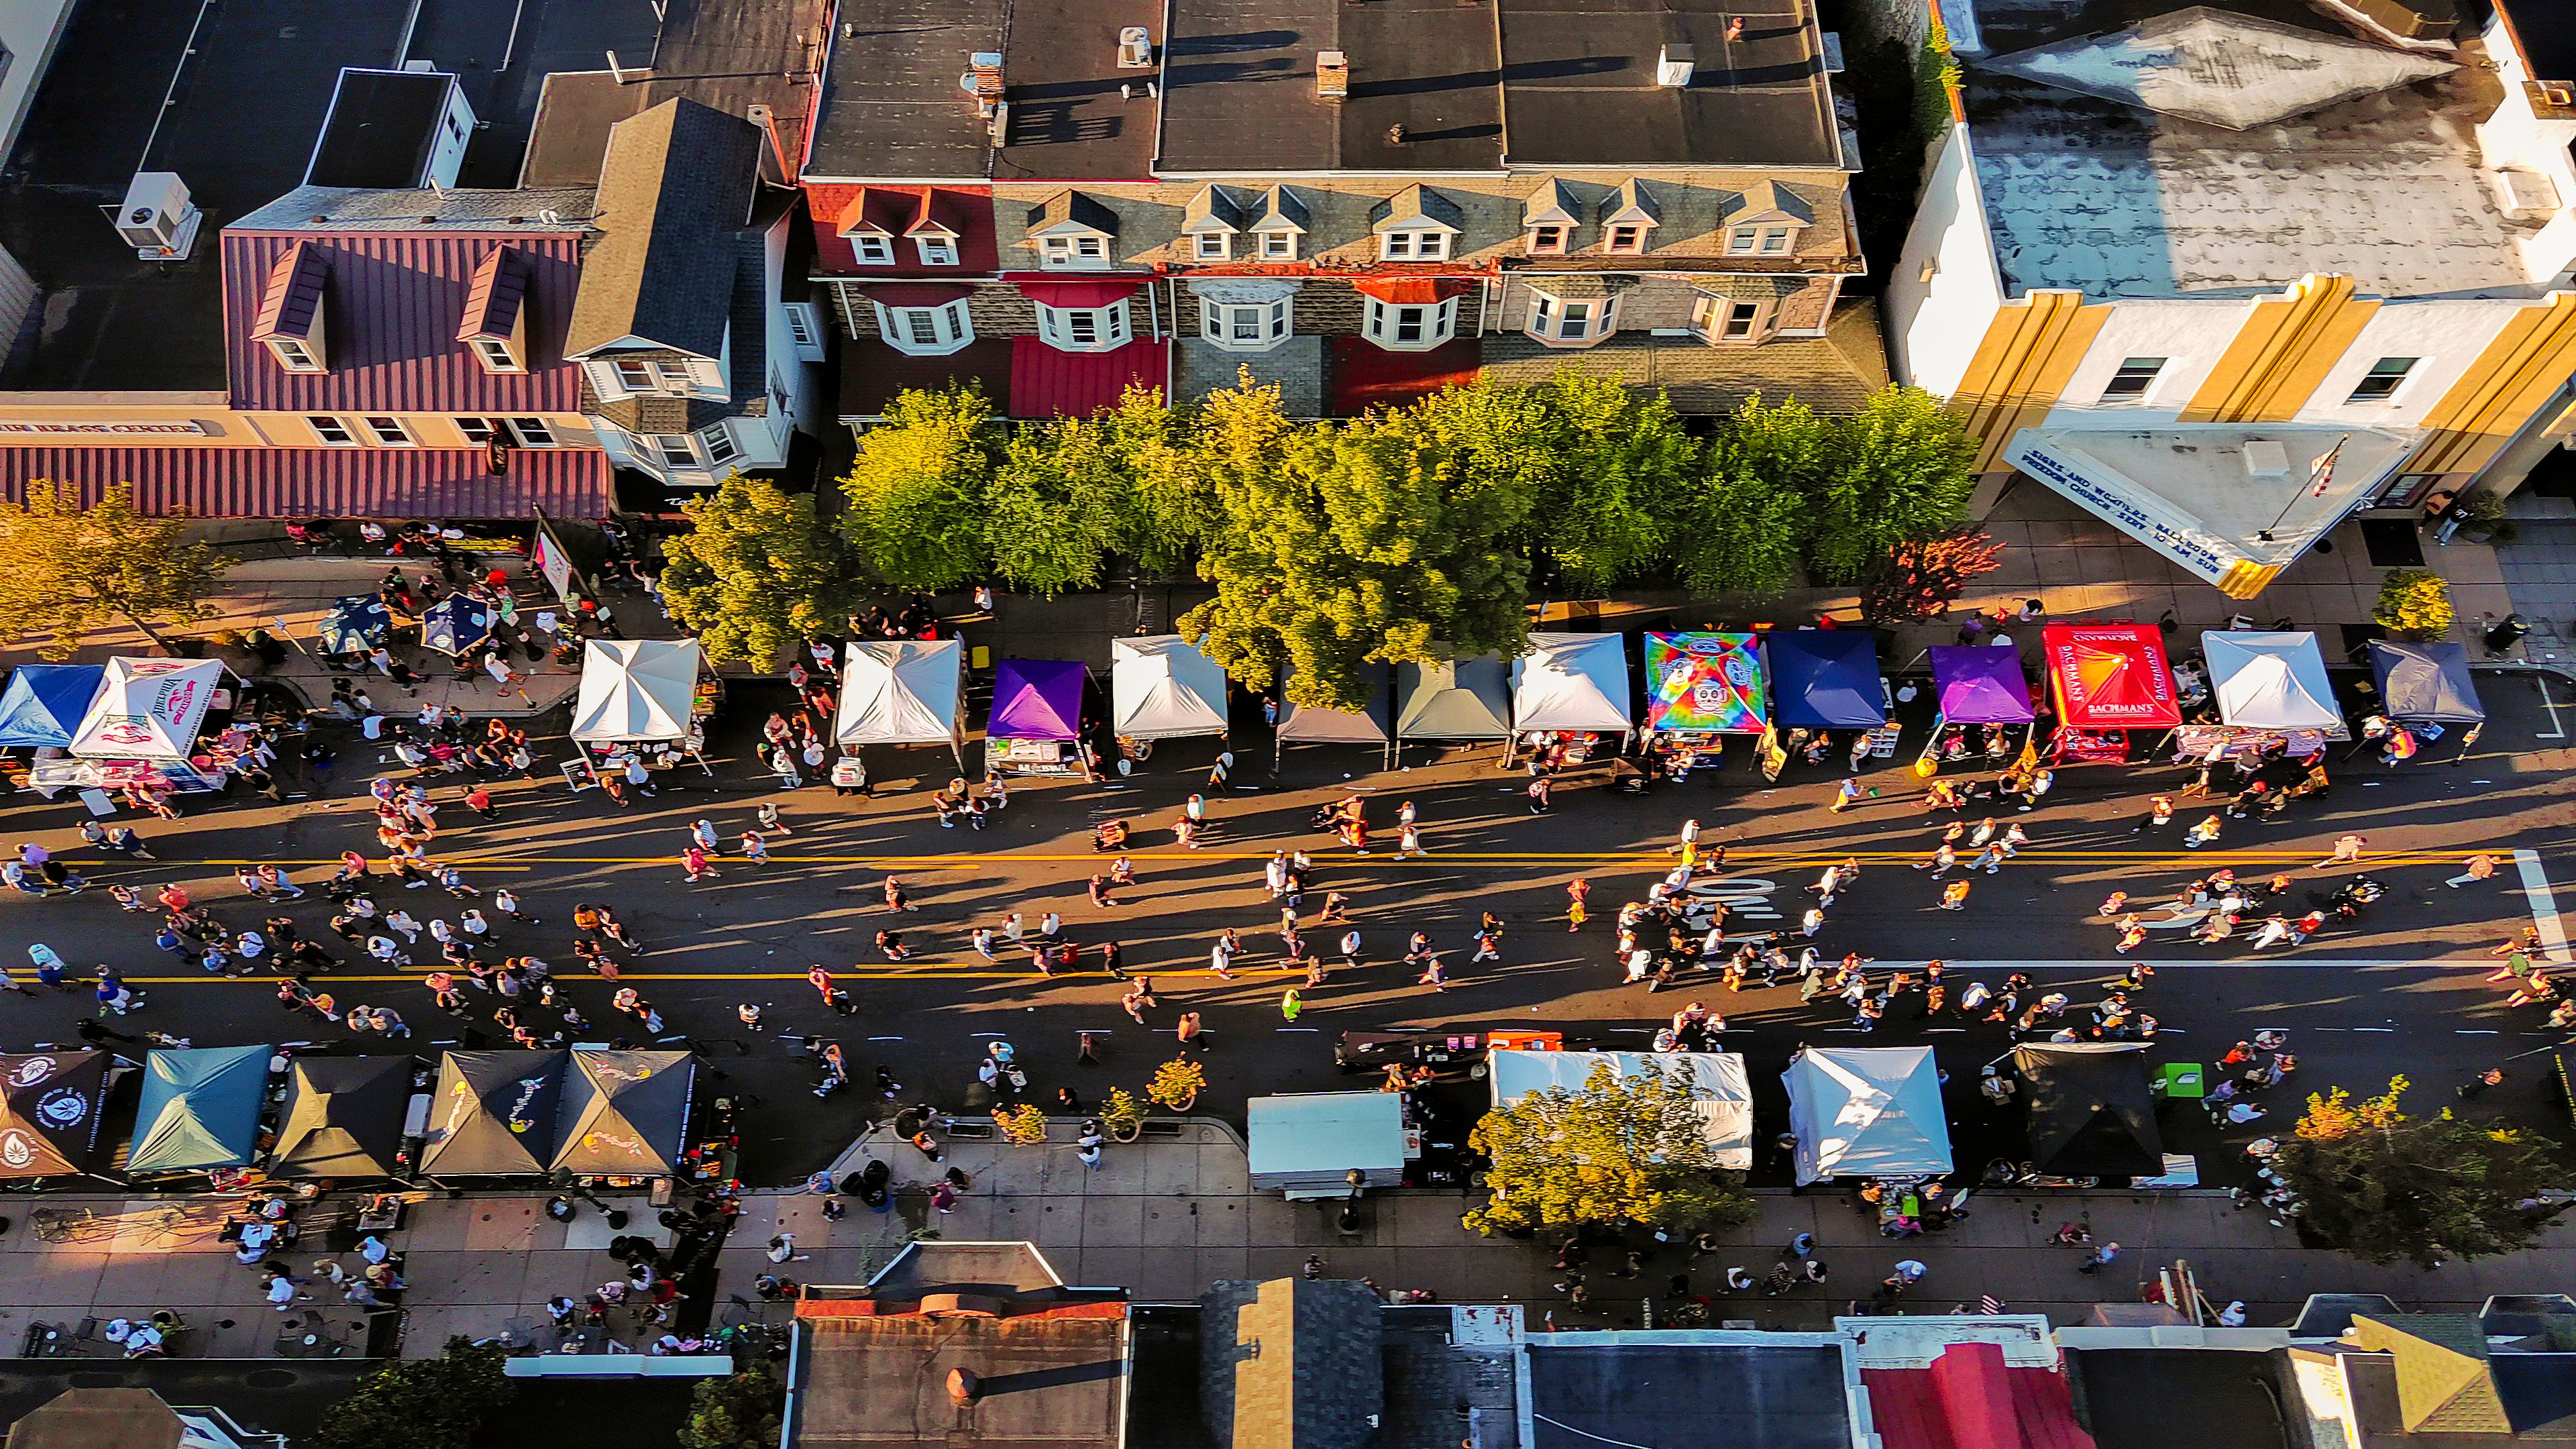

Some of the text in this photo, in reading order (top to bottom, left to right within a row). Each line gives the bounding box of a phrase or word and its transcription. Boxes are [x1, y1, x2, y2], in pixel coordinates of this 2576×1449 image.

[111, 424, 203, 433] CENTER
[2021, 454, 2067, 484] FREEDOM
[2070, 483, 2111, 511] CHURCH
[2153, 532, 2166, 542] 10
[2171, 545, 2192, 558] AM
[2196, 557, 2220, 574] SUN
[2031, 450, 2218, 563] SIGNS AND WONDERS BALLROOM
[152, 678, 184, 721] ADELPHIA
[2088, 703, 2155, 713] BACHMAN'S
